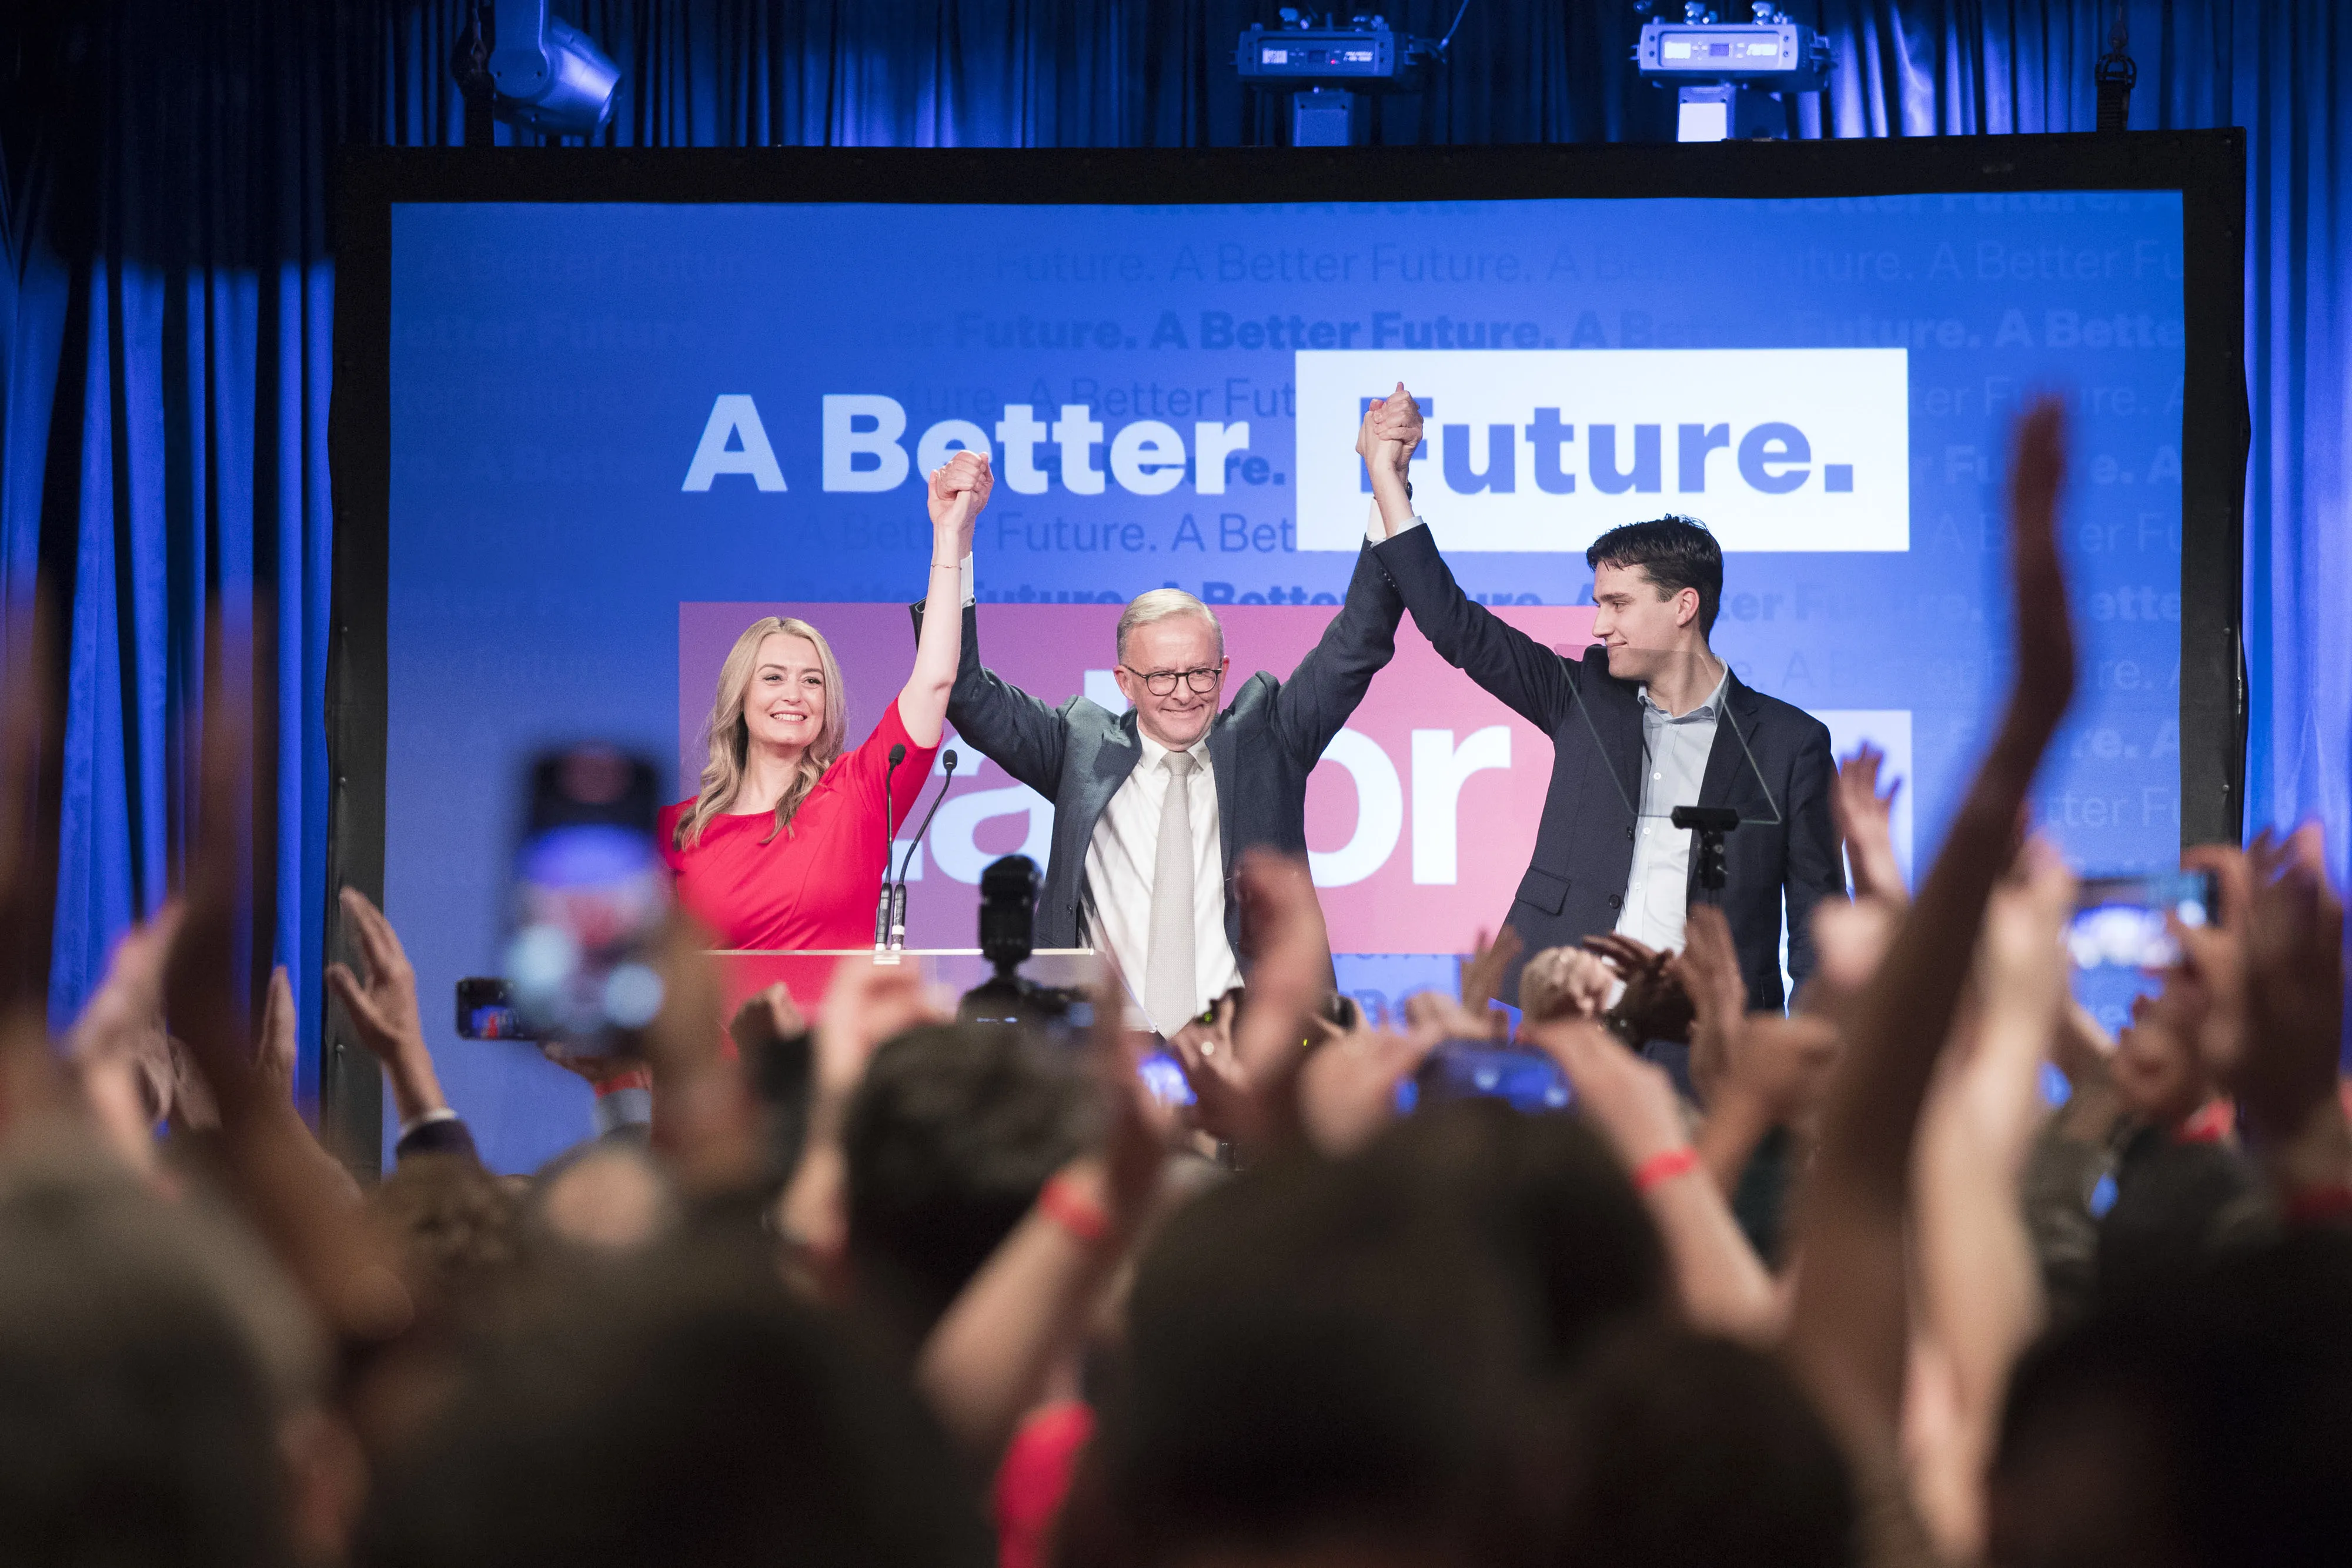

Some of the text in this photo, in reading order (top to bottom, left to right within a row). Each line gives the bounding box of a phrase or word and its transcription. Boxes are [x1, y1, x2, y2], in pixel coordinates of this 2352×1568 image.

[1218, 242, 1359, 282] Better
[1371, 242, 1532, 282] Future.
[954, 310, 1137, 350] Future.
[1147, 310, 1190, 350] A
[1200, 310, 1361, 349] Better
[1371, 310, 1556, 348] Future.
[681, 394, 789, 492] A
[823, 394, 1250, 495] Better
[997, 511, 1157, 553] Future.
[1170, 512, 1207, 553] A
[882, 668, 1511, 888] aor
